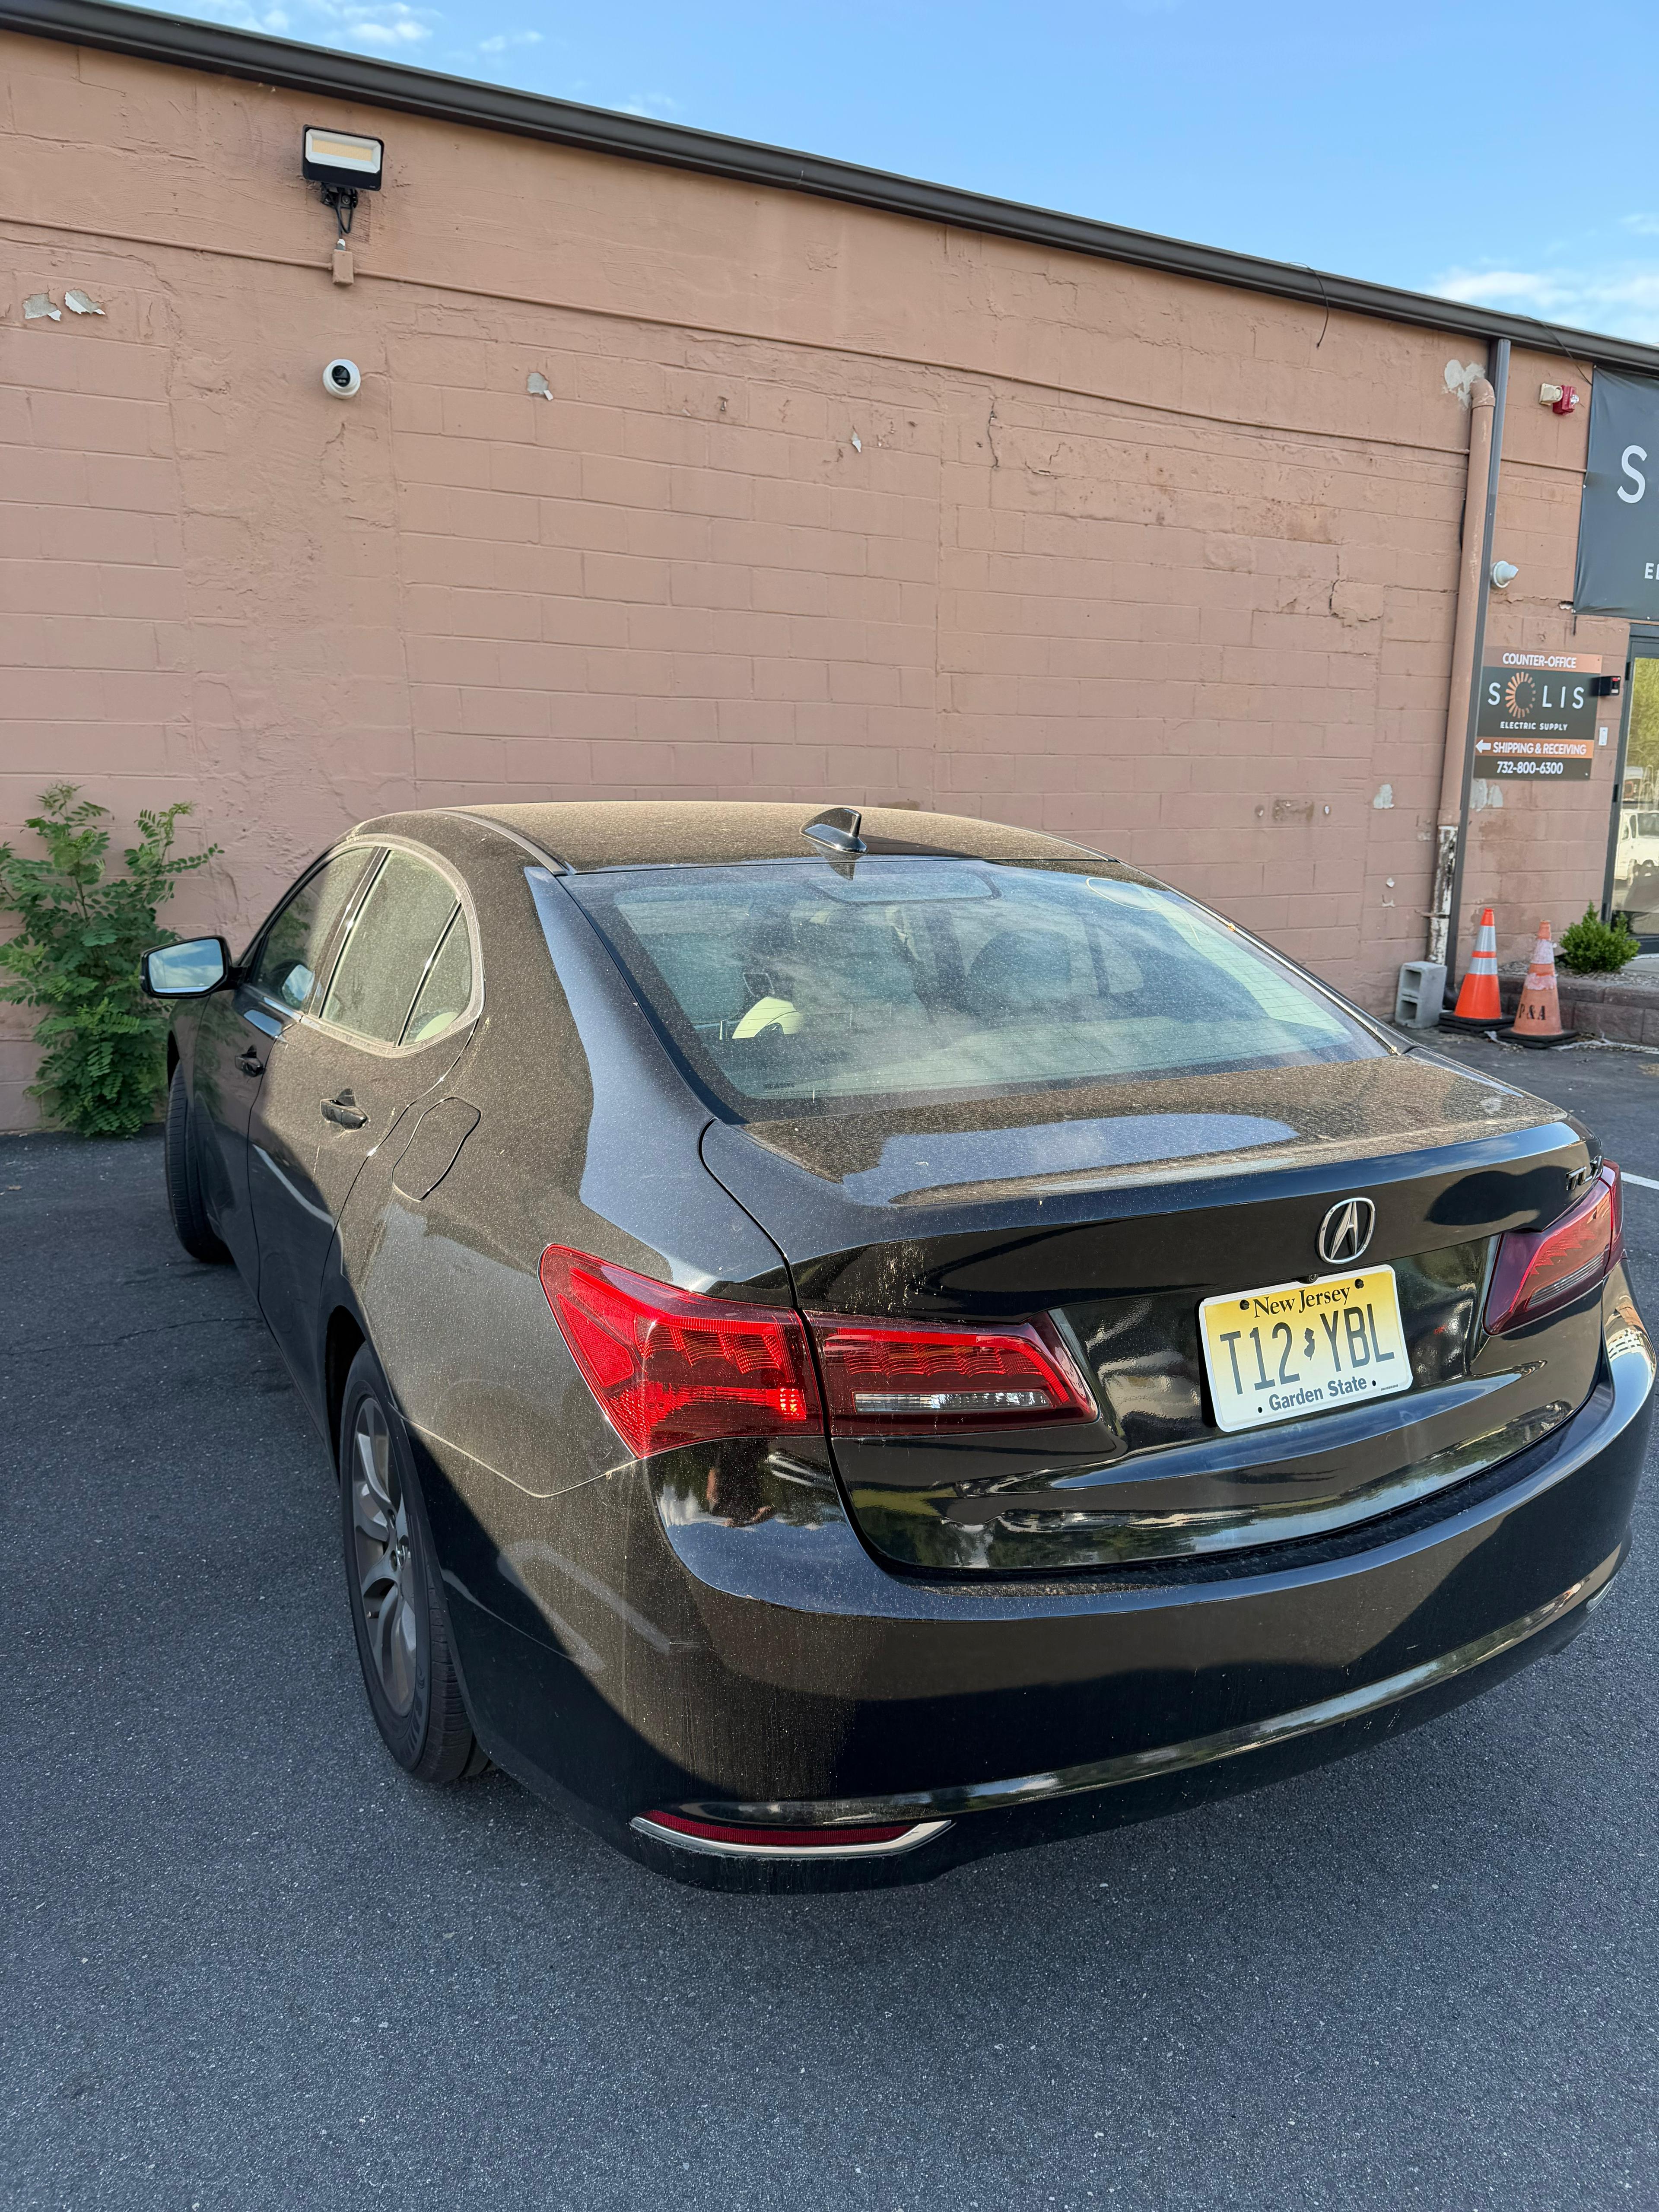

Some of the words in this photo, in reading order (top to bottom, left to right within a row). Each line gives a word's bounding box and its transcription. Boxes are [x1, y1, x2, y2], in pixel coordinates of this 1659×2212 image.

[1502, 652, 1576, 668] COUNTER-OFFICE
[1500, 721, 1536, 730] ELECTRIC
[1493, 742, 1533, 754] SHIPPING
[1535, 743, 1541, 753] &
[1543, 743, 1586, 755] RECEIVING
[1497, 761, 1563, 774] 732-800-6300
[1252, 1297, 1295, 1318] New
[1299, 1287, 1350, 1313] Jersey
[1269, 1387, 1324, 1411] Garden
[1328, 1376, 1367, 1397] State
